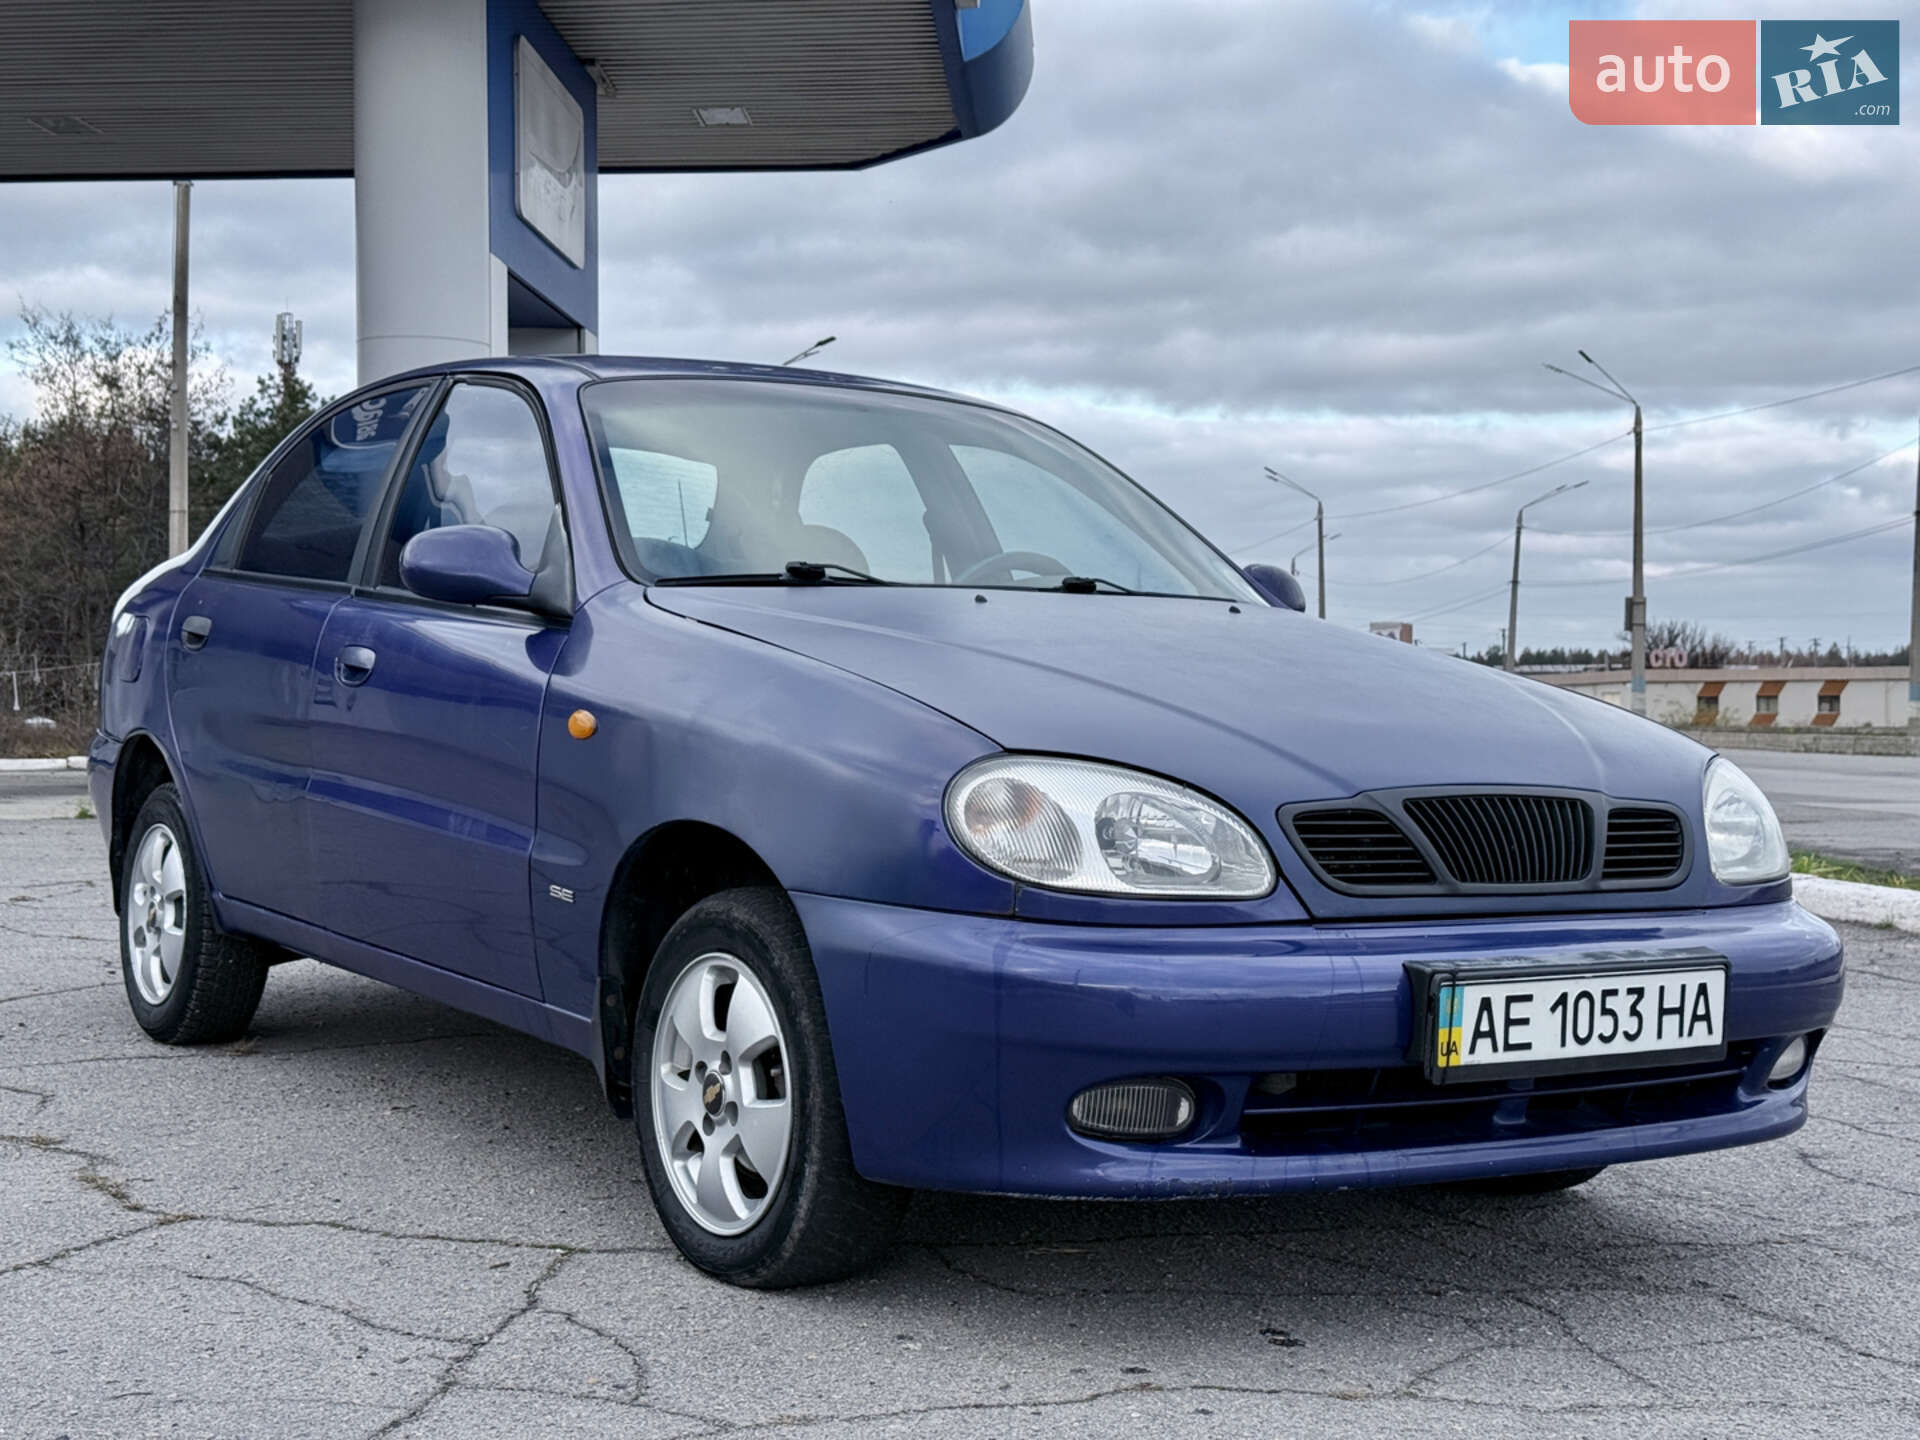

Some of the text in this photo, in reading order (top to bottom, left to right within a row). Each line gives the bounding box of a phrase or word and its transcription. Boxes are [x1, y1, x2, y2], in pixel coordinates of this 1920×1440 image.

[1468, 982, 1714, 1055] AE 1053 HA
[1440, 1040, 1459, 1057] UA
